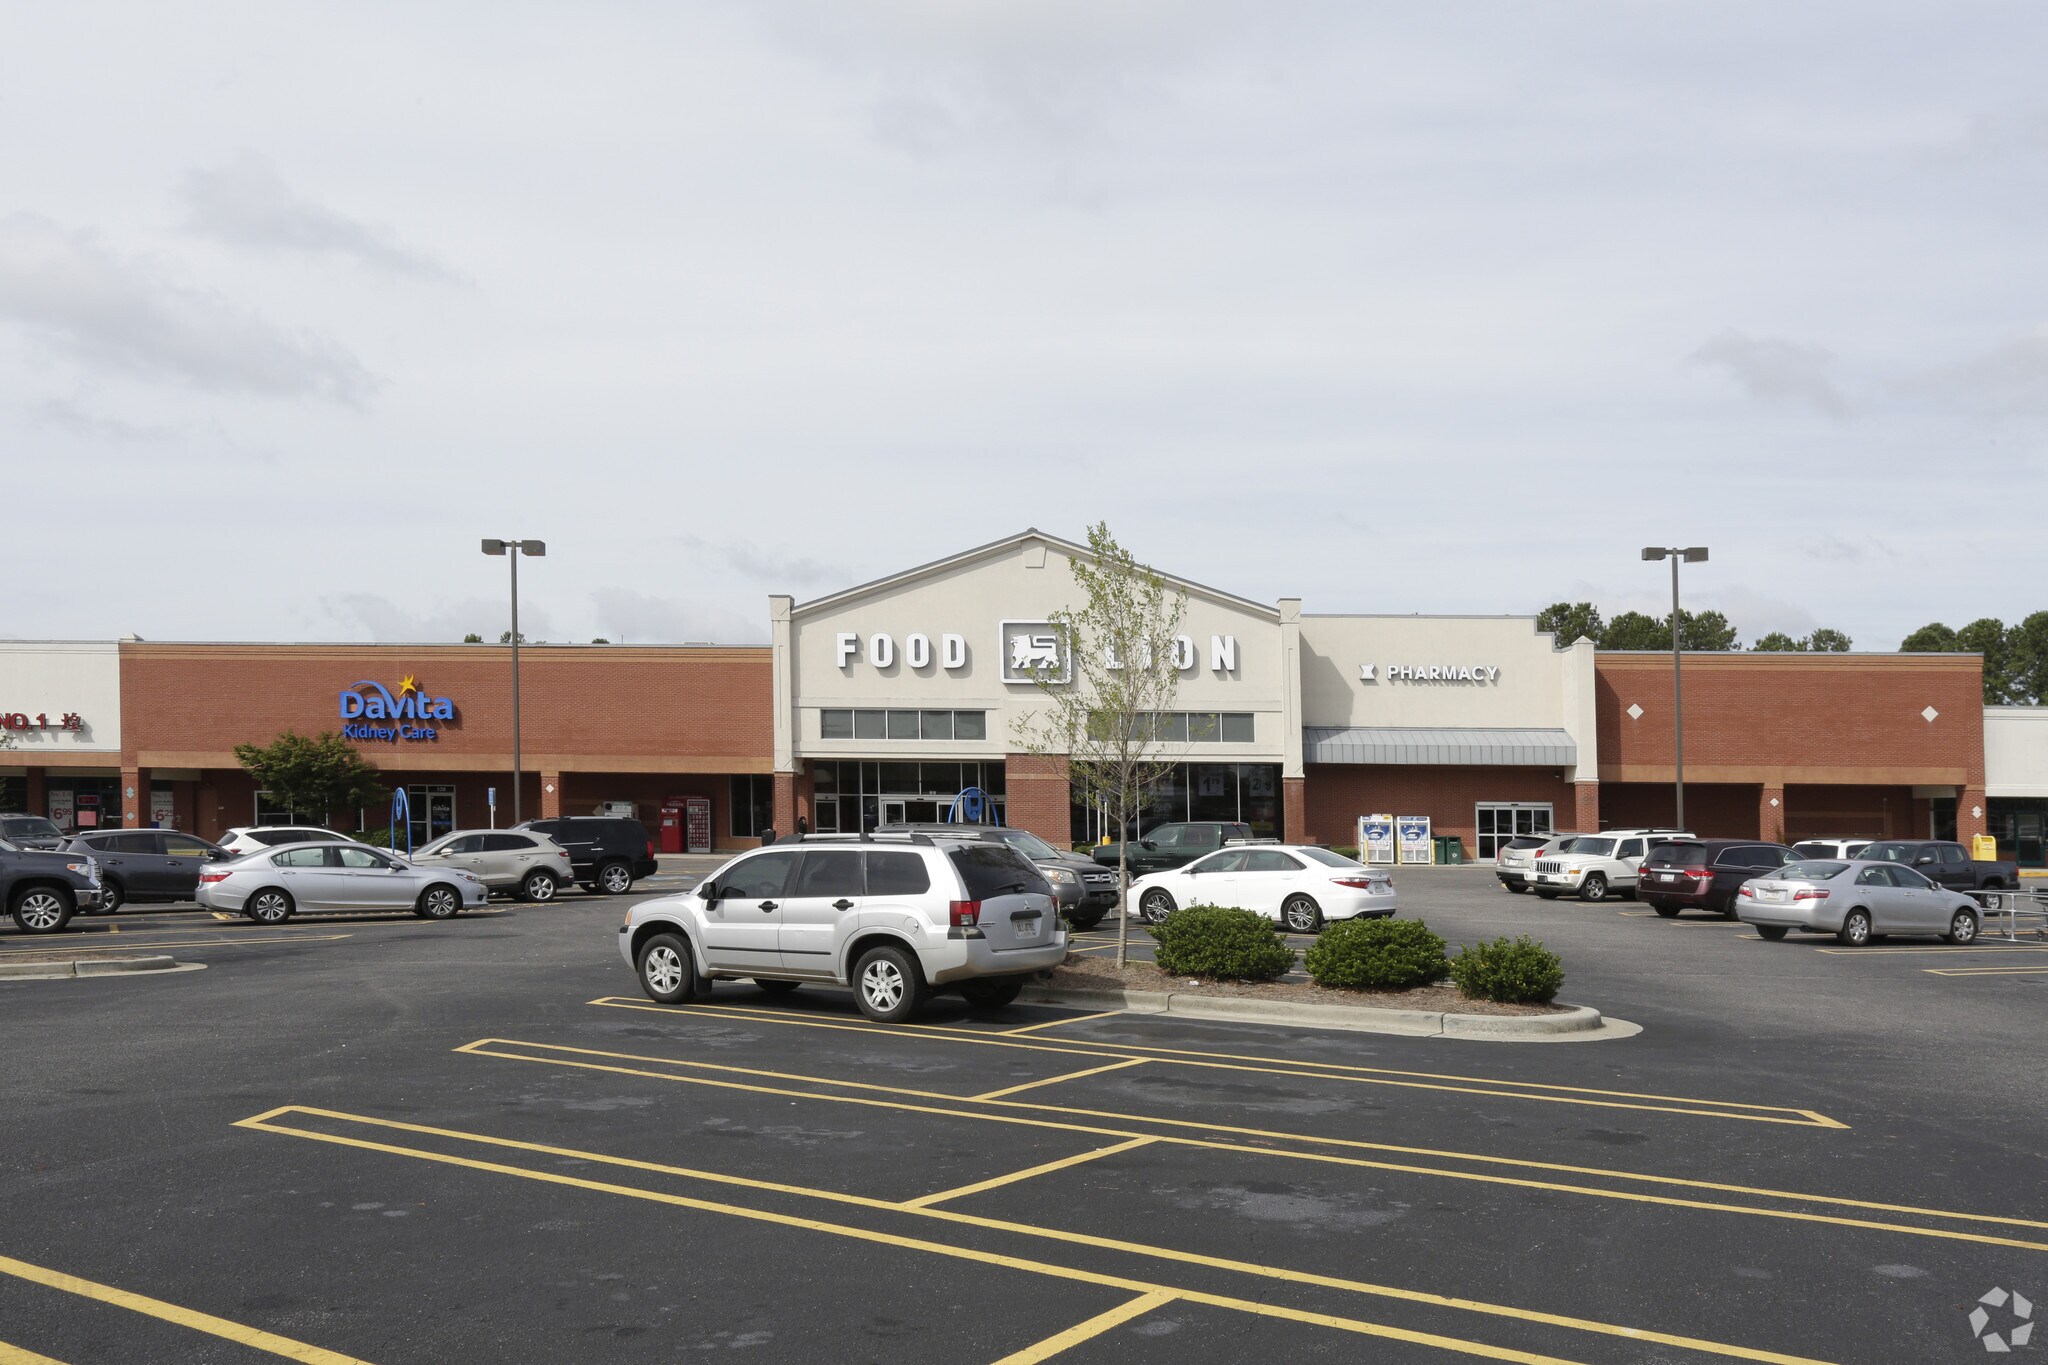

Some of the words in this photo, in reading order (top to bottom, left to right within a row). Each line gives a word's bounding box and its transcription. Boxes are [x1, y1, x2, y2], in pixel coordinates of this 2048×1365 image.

[836, 632, 966, 669] FOOD
[1387, 665, 1498, 681] PHARMACY
[344, 724, 396, 741] Kidney
[400, 724, 436, 739] Care
